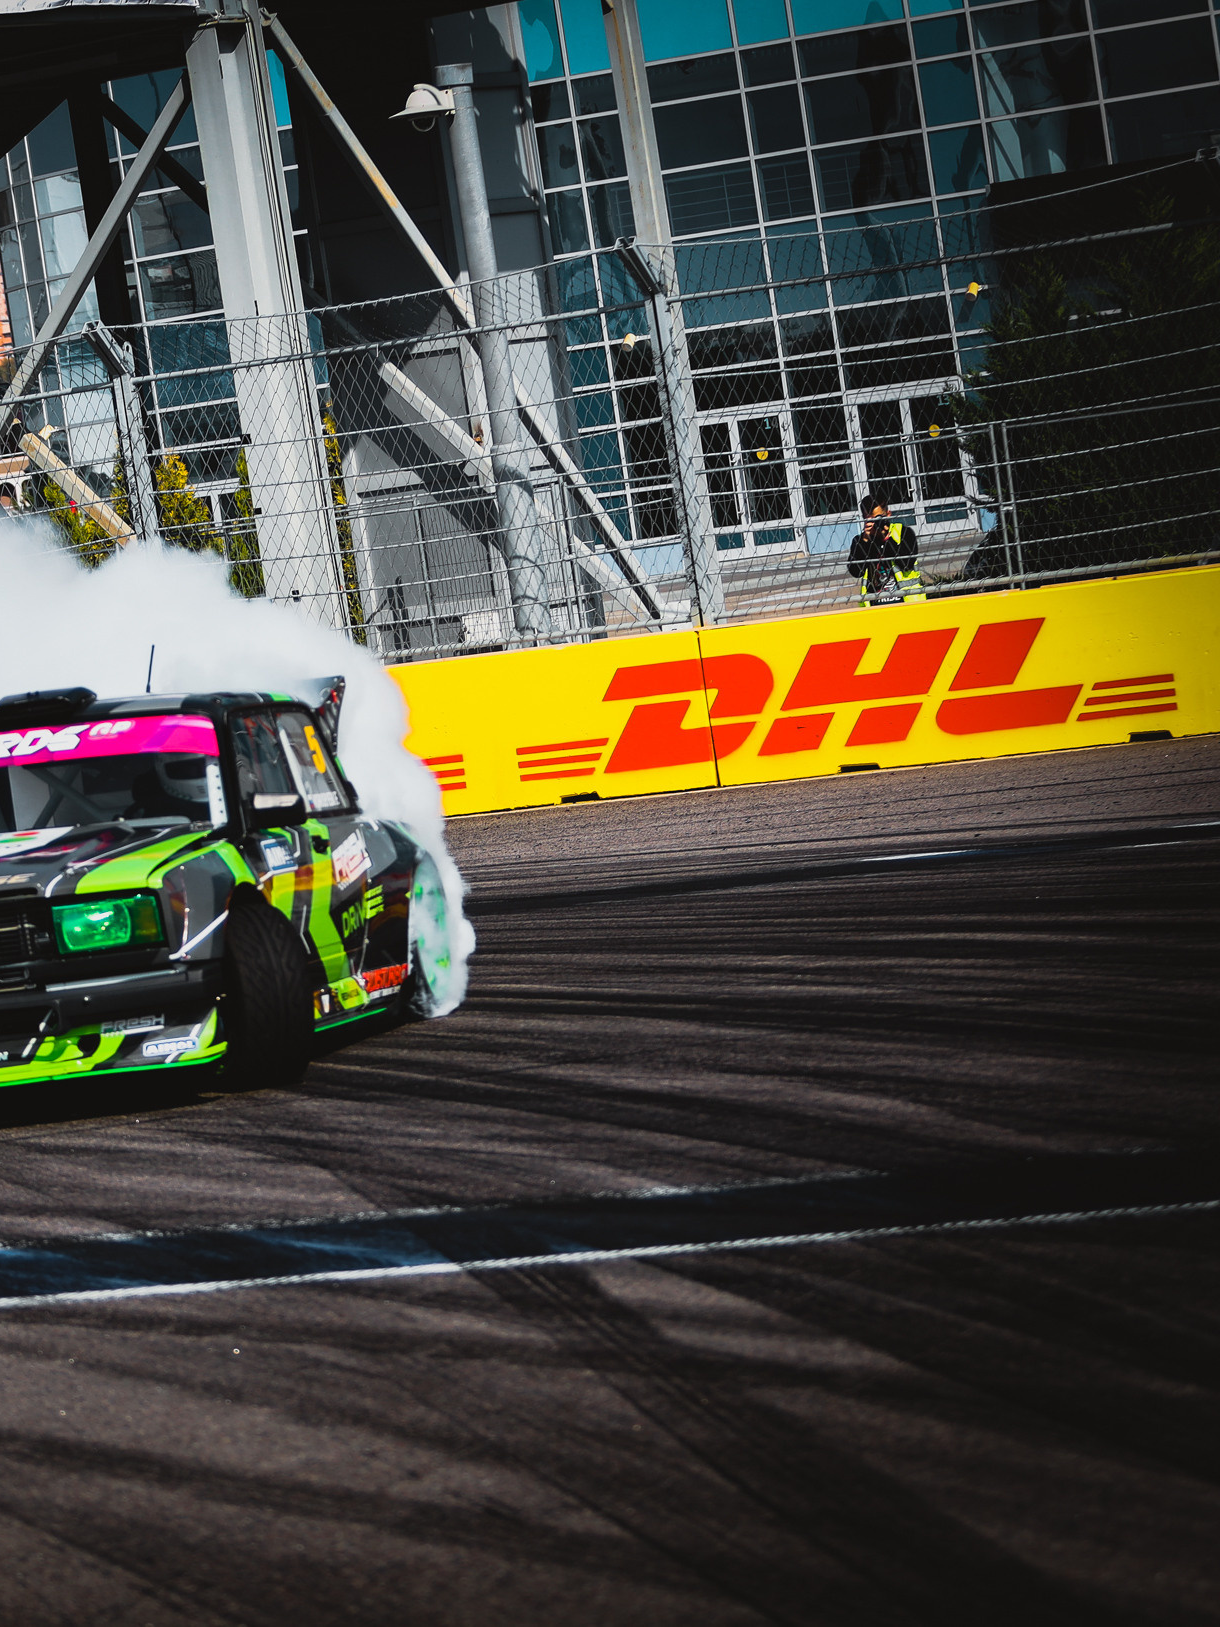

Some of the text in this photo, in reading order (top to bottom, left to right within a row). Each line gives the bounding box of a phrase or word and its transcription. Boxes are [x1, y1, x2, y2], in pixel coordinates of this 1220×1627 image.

[602, 617, 1083, 774] DHL
[303, 725, 327, 774] 5
[100, 1013, 165, 1035] FRESH
